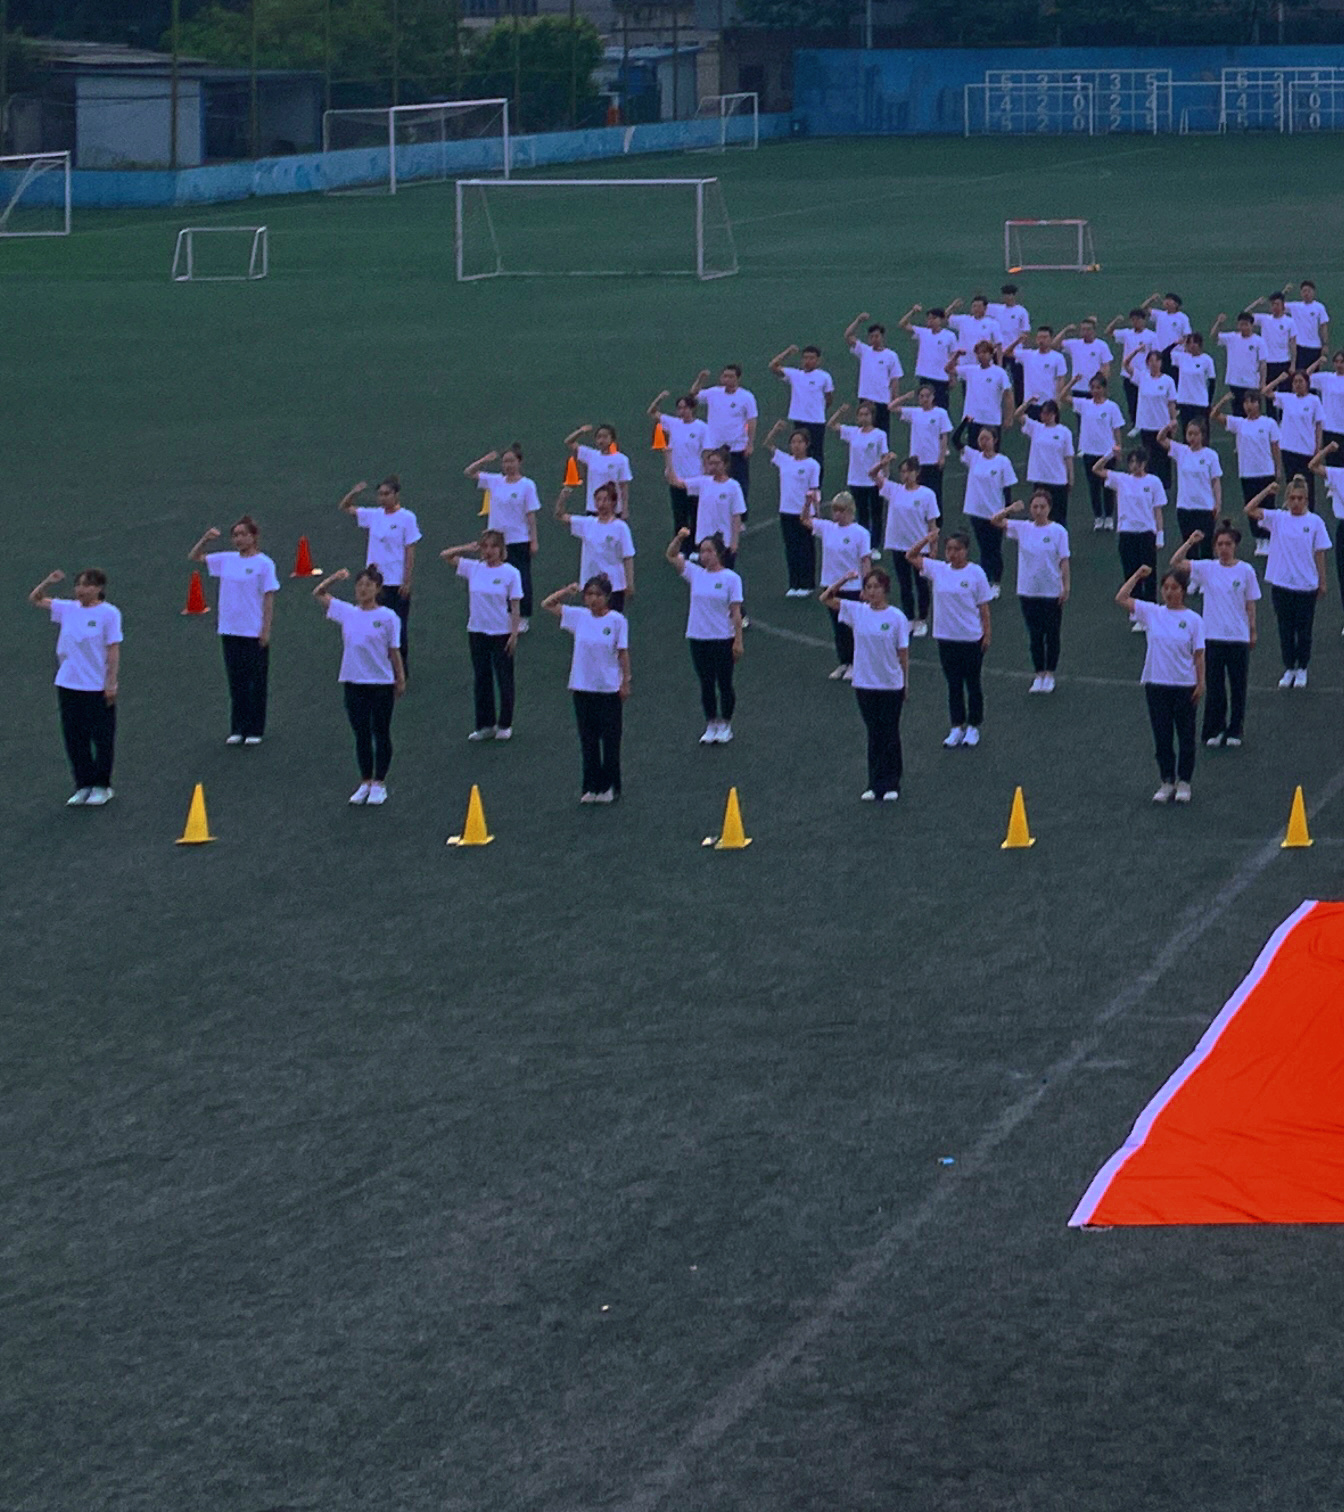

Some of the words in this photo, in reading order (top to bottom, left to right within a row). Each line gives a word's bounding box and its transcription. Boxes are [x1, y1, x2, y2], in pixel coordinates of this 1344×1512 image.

[1110, 73, 1121, 90] 3
[1145, 73, 1156, 90] 5
[1001, 95, 1012, 110] 4
[1037, 95, 1049, 110] 2
[1072, 94, 1085, 110] 0
[1110, 94, 1121, 110] 2
[1237, 93, 1248, 108] 4
[1309, 92, 1321, 108] 0
[1001, 115, 1012, 130] 5
[1037, 115, 1049, 130] 2
[1072, 115, 1085, 130] 0
[1110, 115, 1121, 130] 2
[1309, 113, 1321, 128] 0
